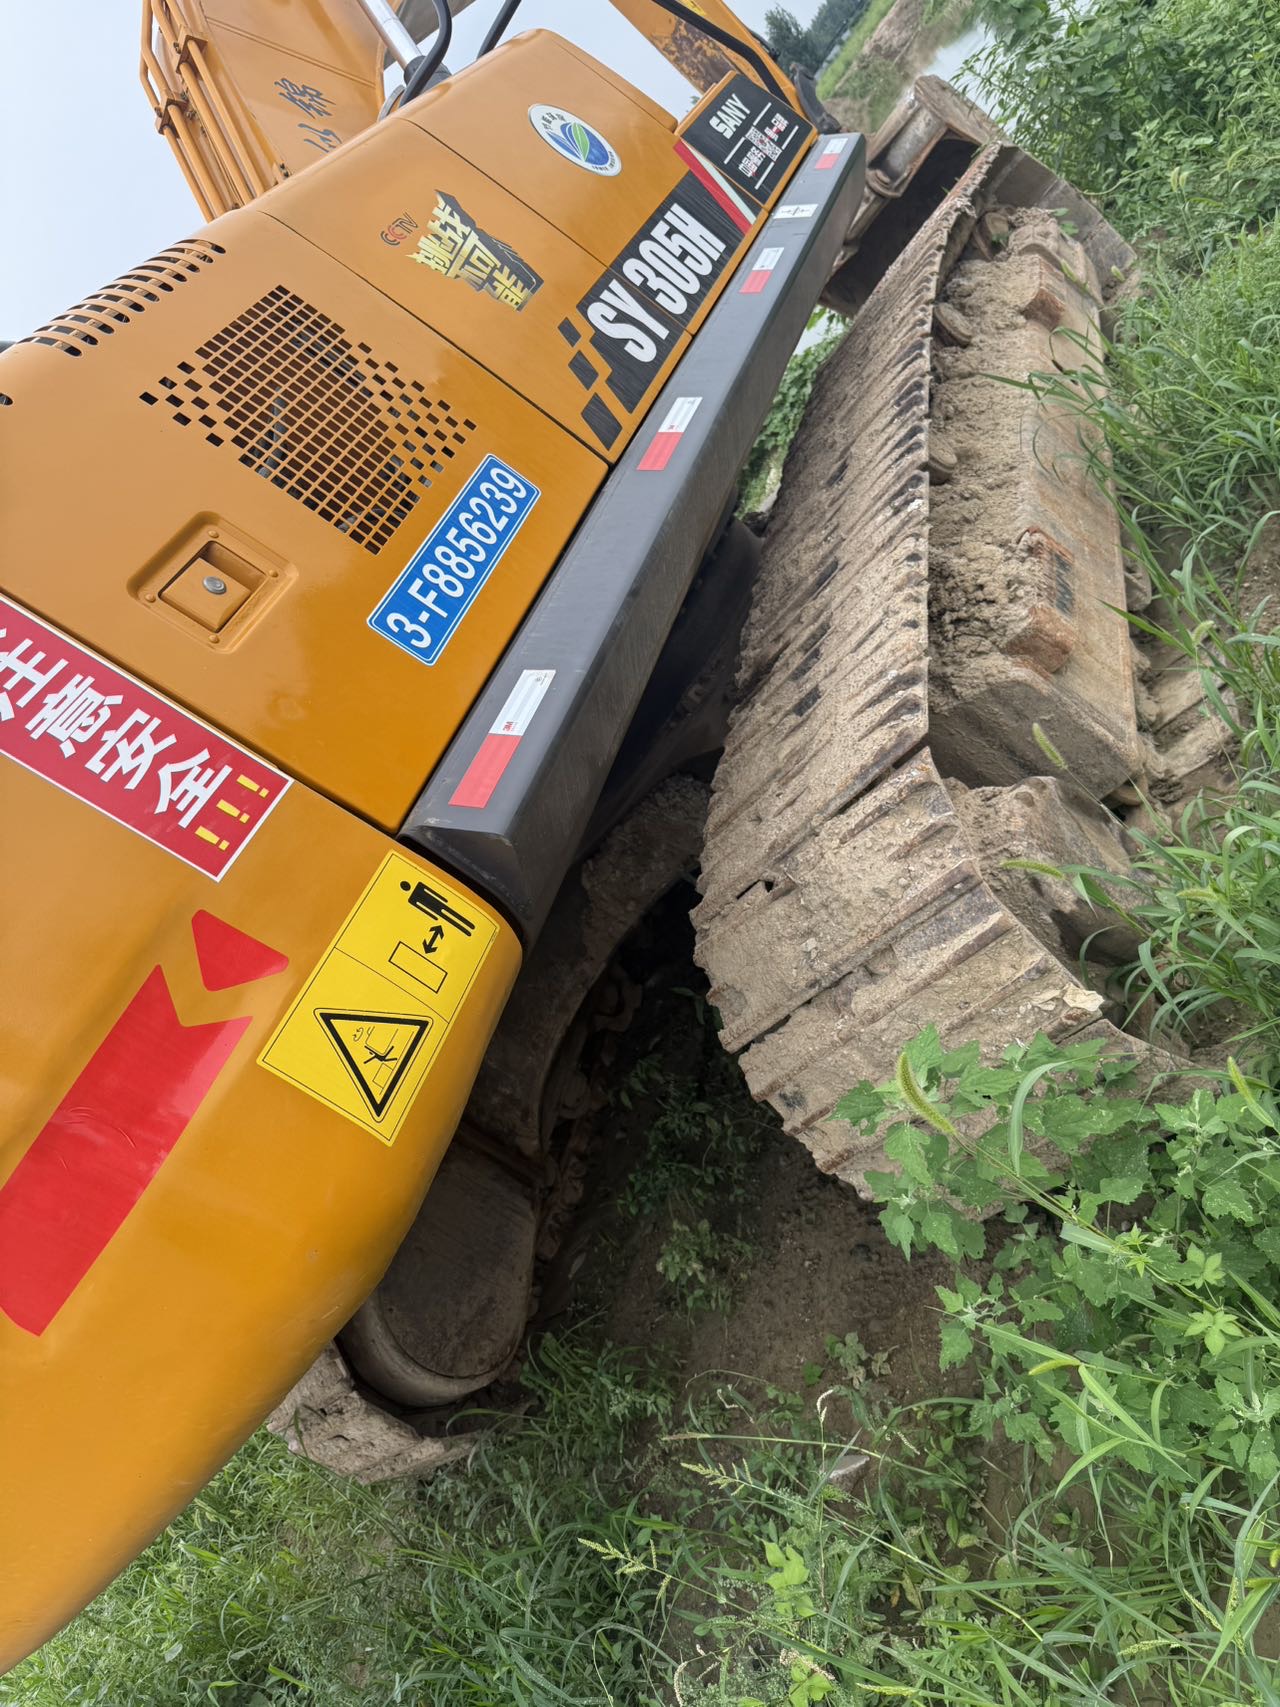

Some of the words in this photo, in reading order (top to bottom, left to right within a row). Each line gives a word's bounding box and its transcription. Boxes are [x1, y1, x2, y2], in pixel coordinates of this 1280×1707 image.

[708, 93, 751, 140] SANY
[380, 211, 419, 246] CCTV
[386, 467, 527, 648] 3-F8856239
